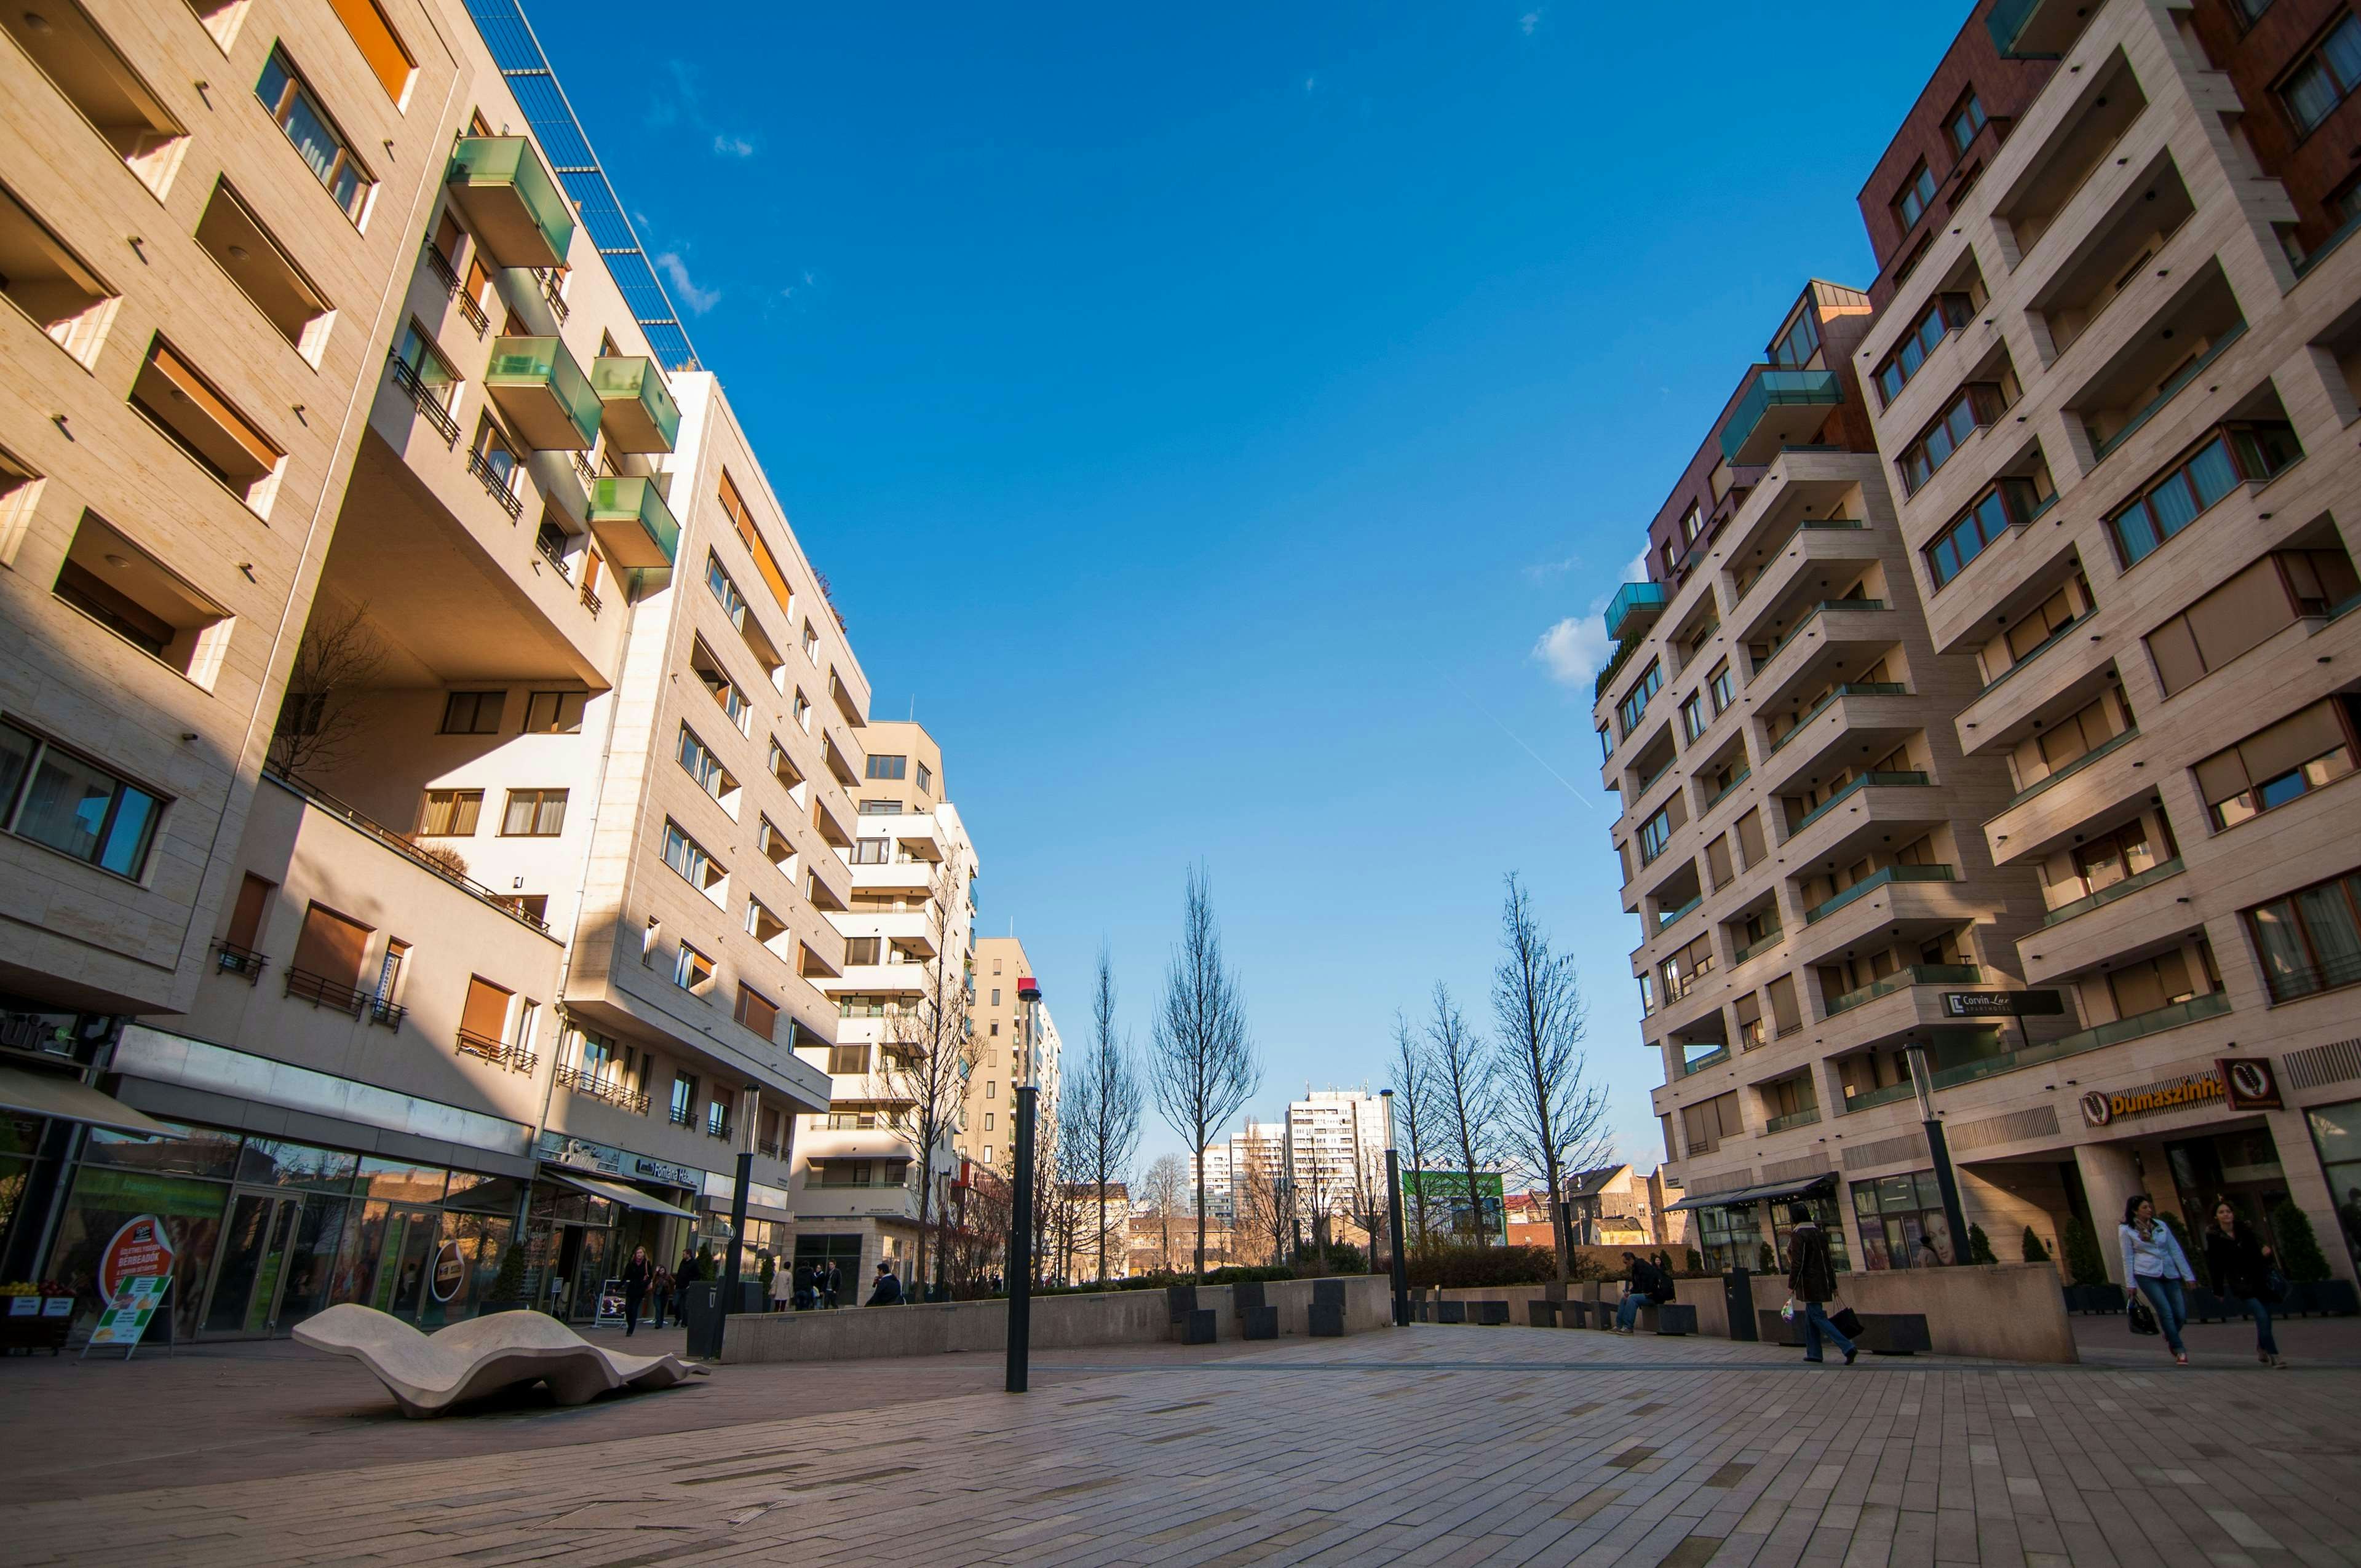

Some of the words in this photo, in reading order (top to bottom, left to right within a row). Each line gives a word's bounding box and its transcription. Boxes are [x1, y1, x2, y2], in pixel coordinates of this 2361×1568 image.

[1962, 995, 1990, 1005] Corvin
[2111, 1077, 2224, 1115] Dumaszínhá
[654, 1163, 678, 1180] Fontana
